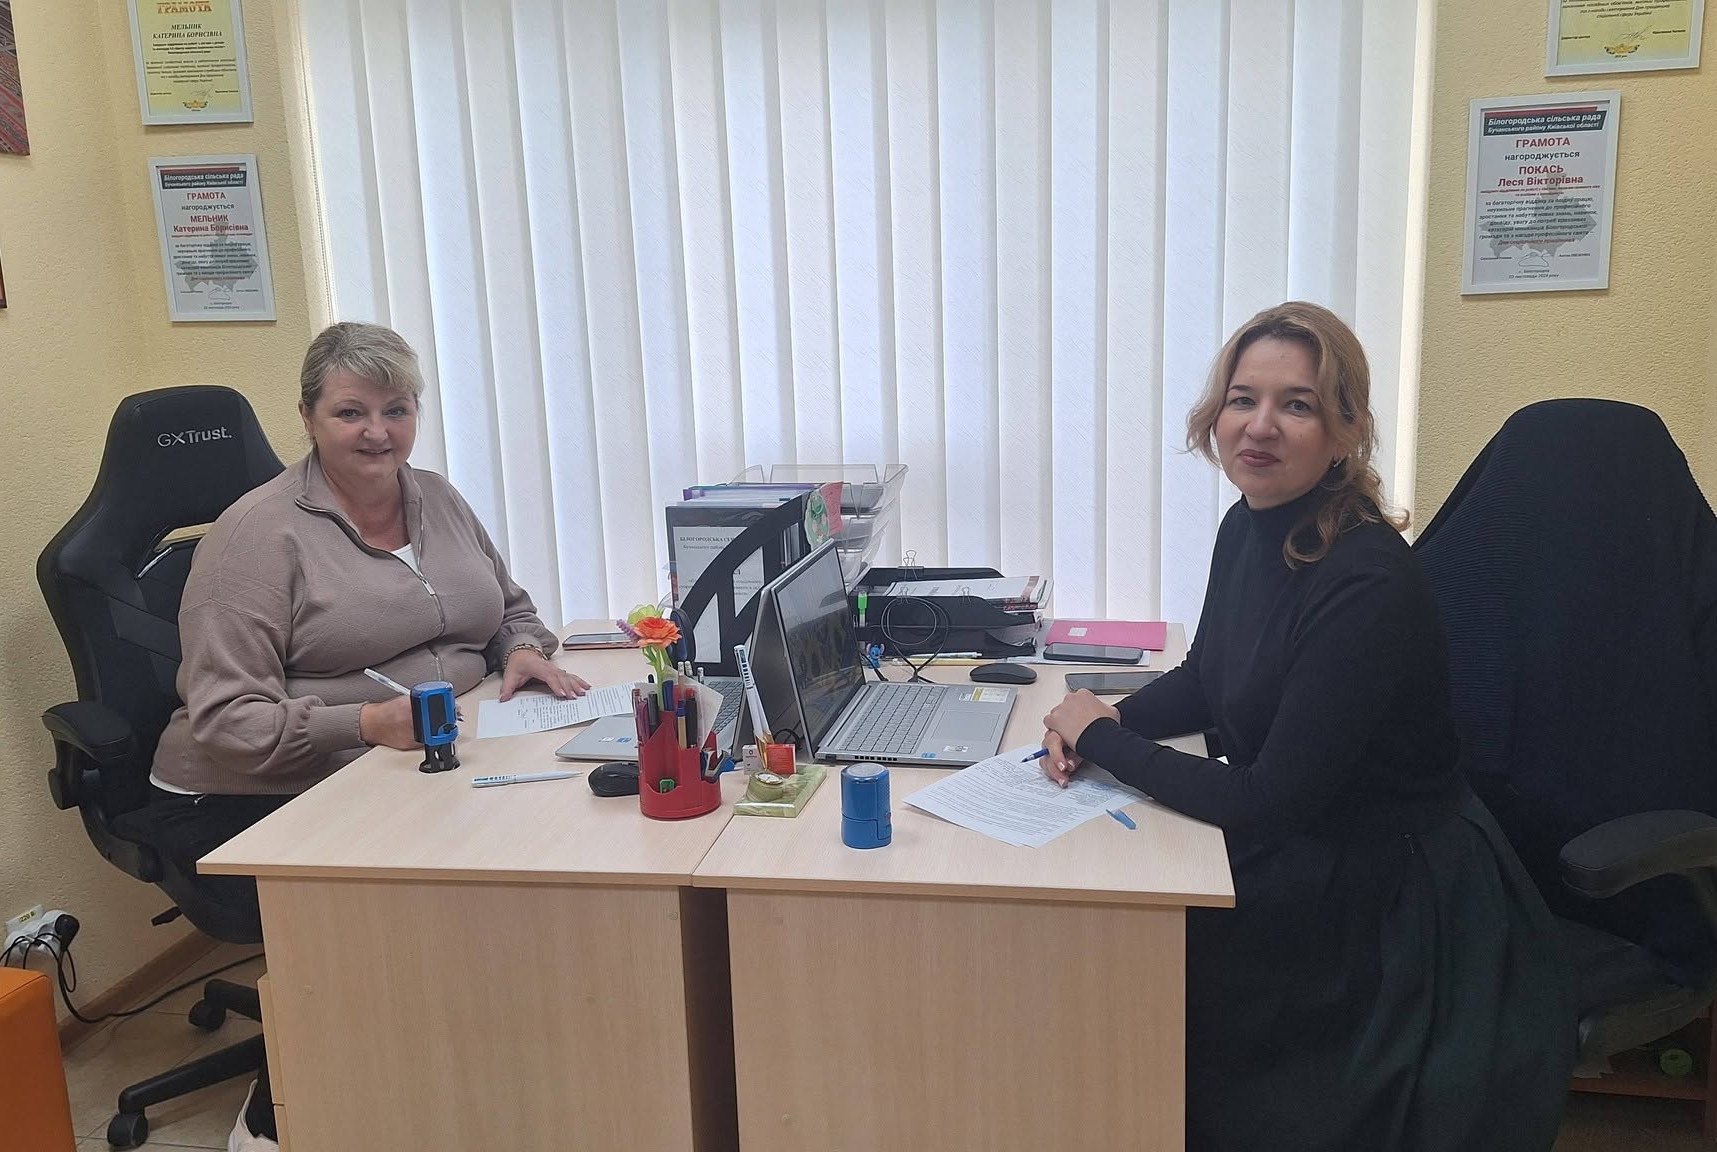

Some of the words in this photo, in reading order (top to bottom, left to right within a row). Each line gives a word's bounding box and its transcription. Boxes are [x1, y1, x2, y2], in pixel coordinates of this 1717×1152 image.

[152, 32, 186, 40] КАТЕРИНА
[1488, 118, 1545, 126] Білогородська
[1546, 115, 1581, 123] сільська
[1581, 113, 1601, 122] рада
[1516, 137, 1571, 149] ГРАМОТА
[1504, 151, 1581, 161] нагороджується
[1519, 165, 1565, 175] ПОКАСЬ
[163, 172, 204, 182] Білогородська
[204, 171, 230, 180] сільська
[230, 171, 244, 179] рада
[1497, 178, 1525, 188] Леся
[1526, 175, 1584, 186] Вікторівна
[186, 191, 227, 201] ГРАМОТА
[181, 203, 235, 213] нагороджується
[190, 214, 229, 223] МЕЛЬНИК
[173, 225, 209, 234] Катерина
[210, 223, 249, 232] Борисівна
